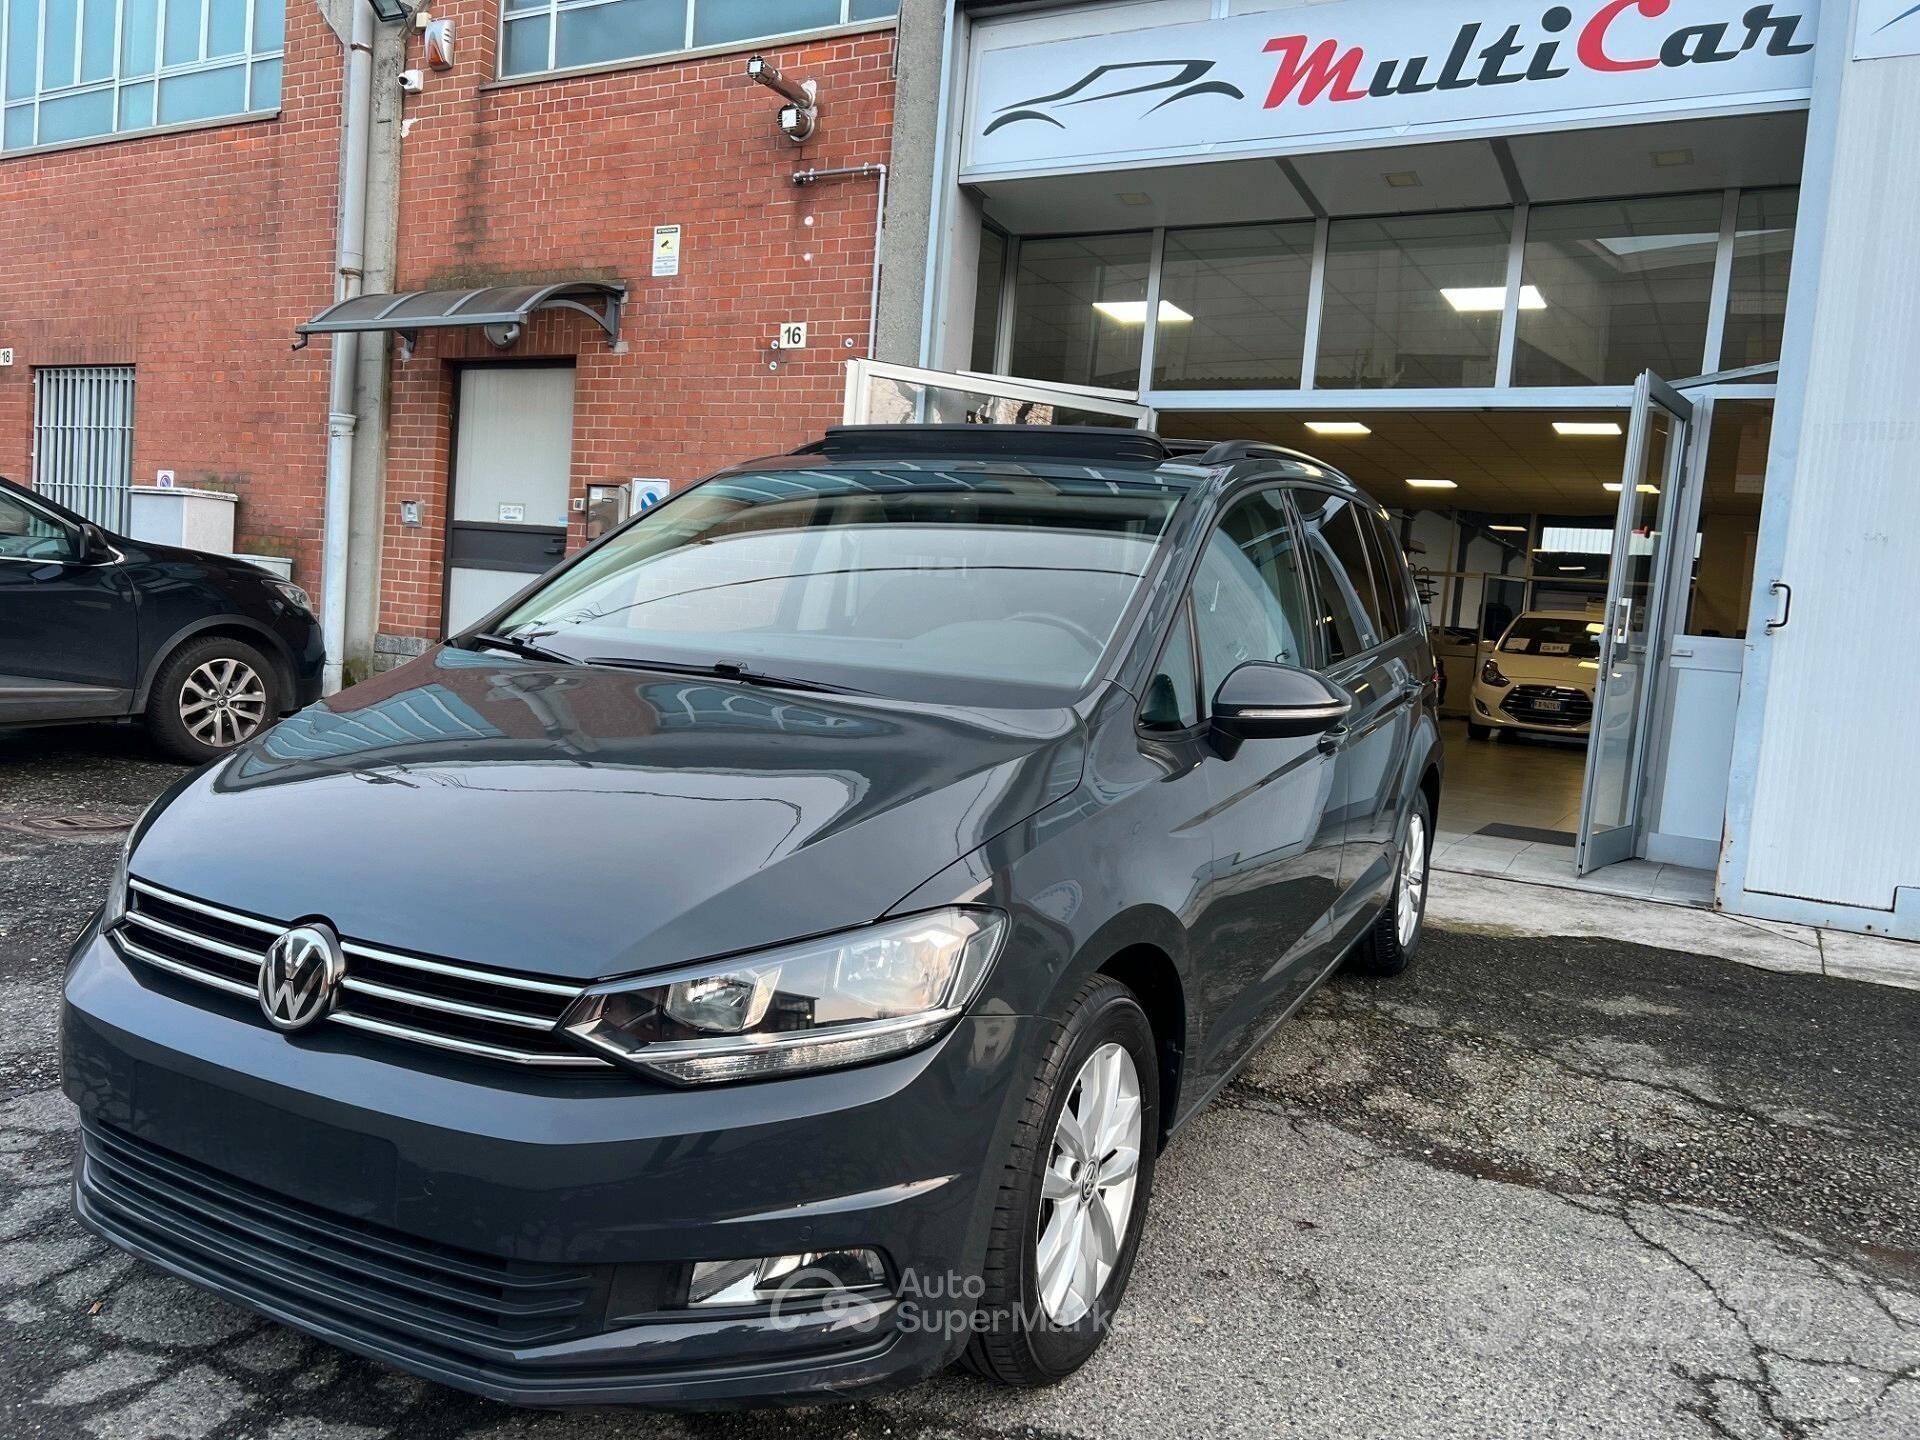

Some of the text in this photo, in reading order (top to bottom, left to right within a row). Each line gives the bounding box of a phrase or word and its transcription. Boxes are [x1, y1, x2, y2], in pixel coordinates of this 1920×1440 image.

[1262, 0, 1815, 110] MultiCar
[784, 326, 801, 345] 16
[2, 350, 10, 363] 18
